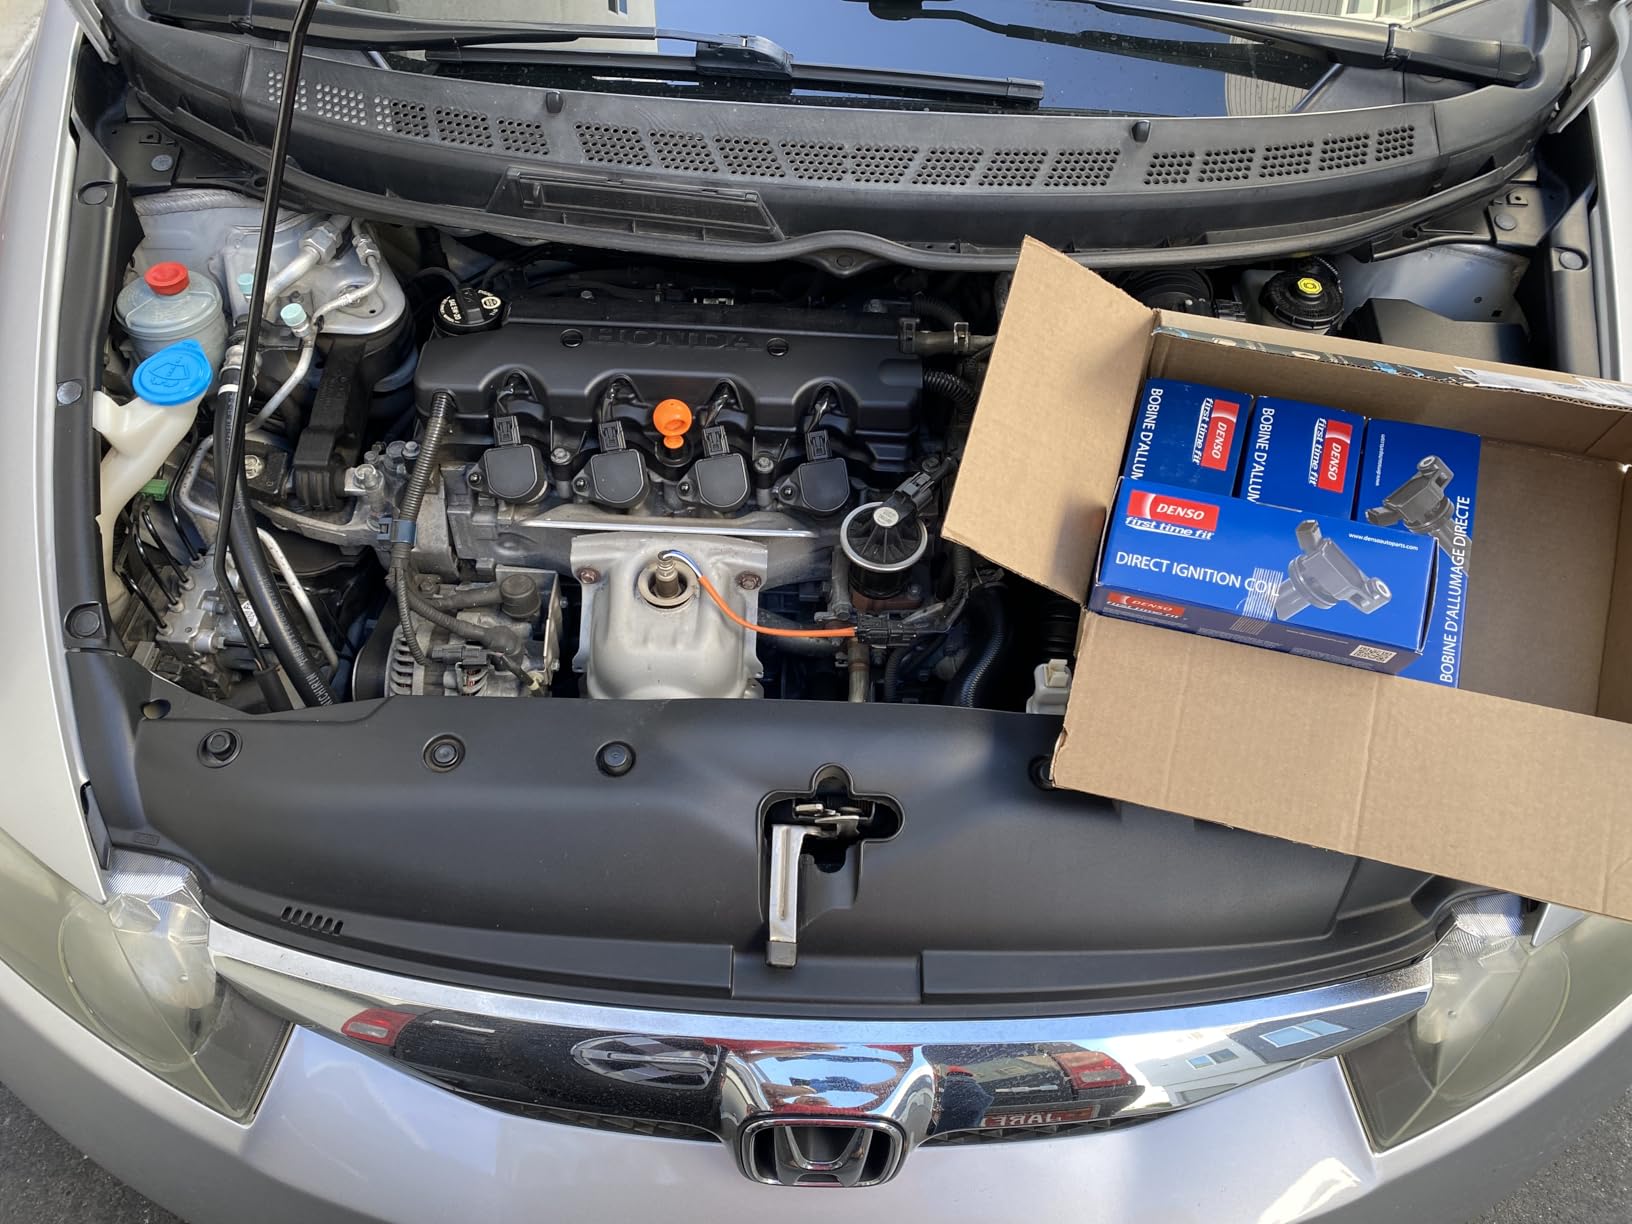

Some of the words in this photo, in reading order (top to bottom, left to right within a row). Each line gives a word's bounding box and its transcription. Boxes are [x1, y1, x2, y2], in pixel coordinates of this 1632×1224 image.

[585, 327, 766, 351] HONDA
[1142, 388, 1164, 431] BOBINE
[1202, 398, 1214, 421] first
[1197, 423, 1208, 449] time
[1211, 422, 1227, 459] DENSO
[1255, 407, 1275, 451] BOBINE
[1316, 417, 1327, 442] first
[1192, 449, 1203, 465] fit
[1311, 443, 1323, 470] time
[1327, 442, 1342, 480] DENSO
[1308, 470, 1319, 487] fit
[1156, 503, 1205, 520] DENSO
[1453, 495, 1470, 547] DIRECTE
[1125, 516, 1157, 529] first
[1159, 523, 1192, 536] time
[1194, 530, 1215, 540] fit
[1115, 551, 1171, 573] DIRECT
[1172, 562, 1242, 589] IGNITION
[1244, 577, 1280, 597] COIL
[1445, 549, 1465, 632] D'ALLUMAGE
[1131, 600, 1173, 612] DENSO
[1439, 633, 1457, 682] BOBINE
